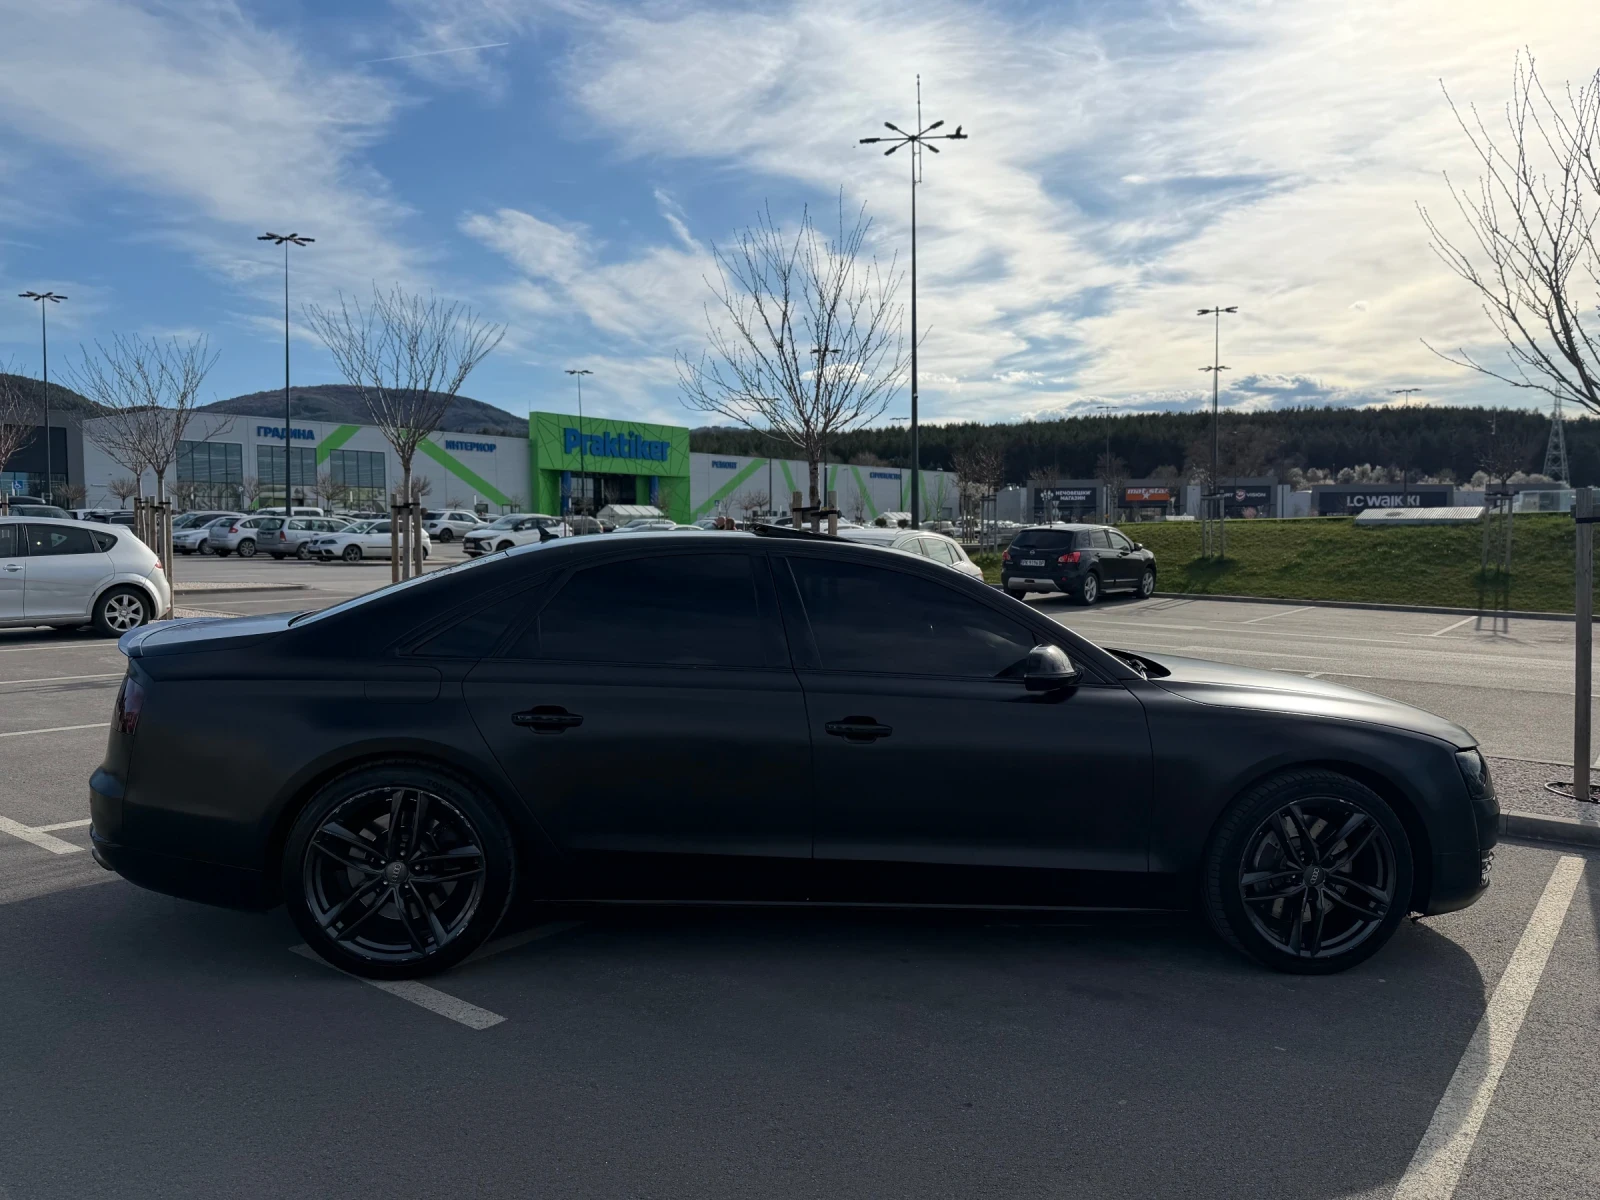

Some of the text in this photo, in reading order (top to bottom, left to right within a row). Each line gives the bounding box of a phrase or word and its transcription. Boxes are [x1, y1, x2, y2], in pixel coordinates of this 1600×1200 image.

[257, 425, 315, 440] ГРАДИНА
[445, 440, 497, 453] ИНТЕРИОР
[563, 427, 670, 462] Praktiker
[1346, 494, 1364, 507] LC
